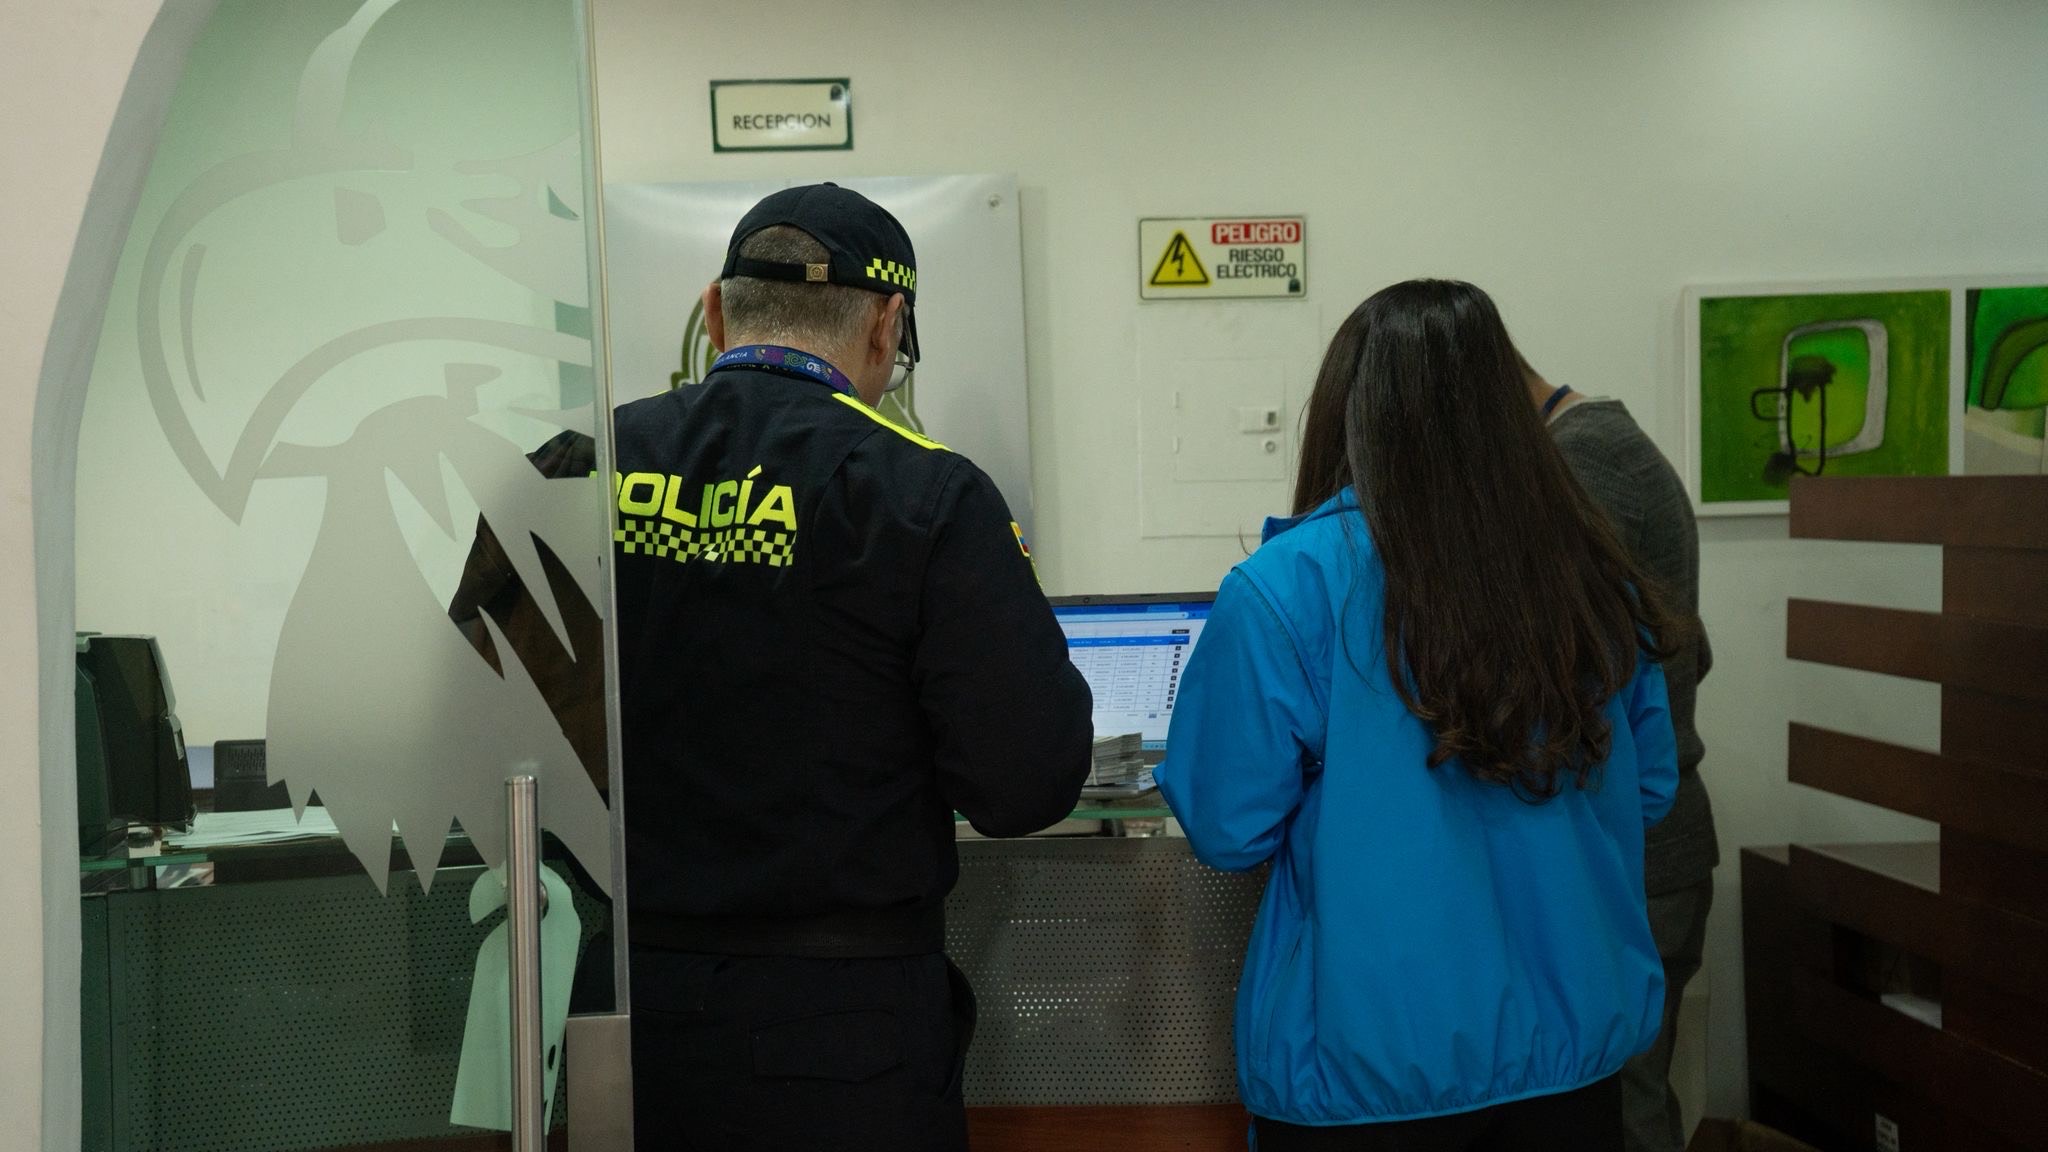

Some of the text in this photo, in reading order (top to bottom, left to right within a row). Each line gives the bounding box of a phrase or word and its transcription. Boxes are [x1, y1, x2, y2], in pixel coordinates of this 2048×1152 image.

[733, 113, 831, 130] RECEPCION
[1215, 223, 1296, 242] PELIGRO
[1229, 248, 1284, 263] RIESGO
[1216, 263, 1297, 279] ELECTRICO
